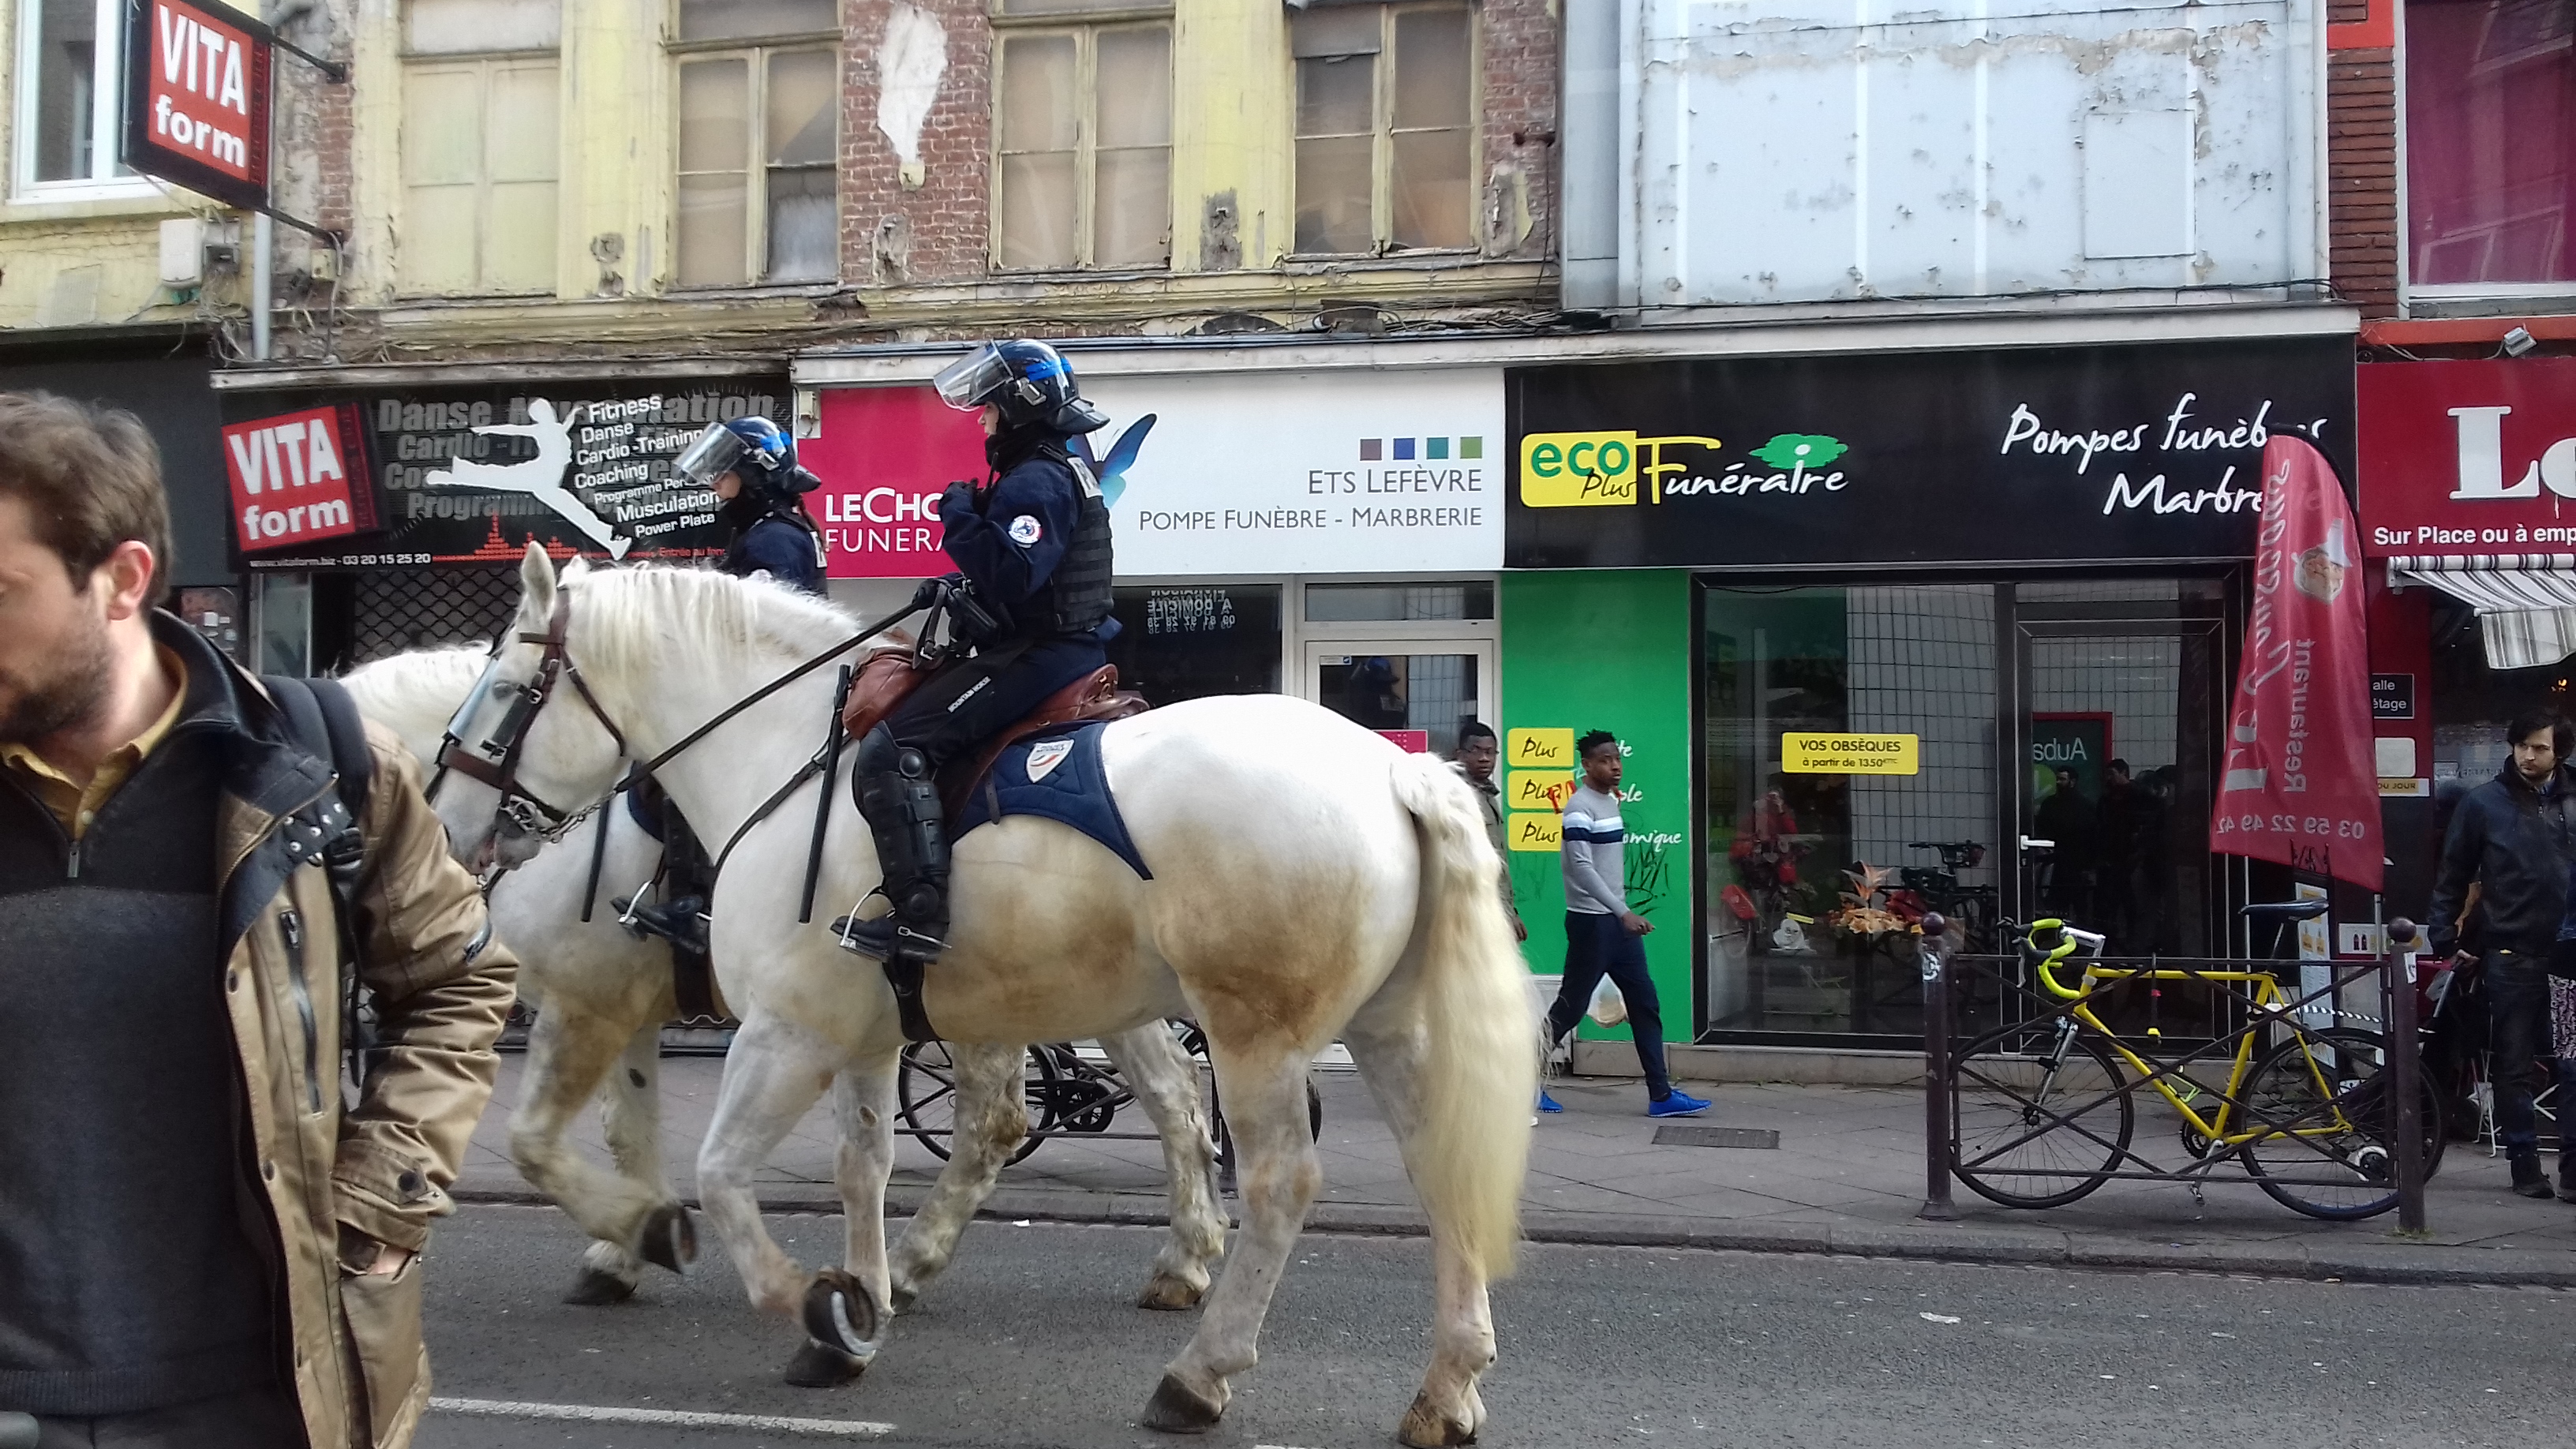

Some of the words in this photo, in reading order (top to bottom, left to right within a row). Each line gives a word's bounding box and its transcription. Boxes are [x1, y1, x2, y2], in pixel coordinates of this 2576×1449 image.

[159, 3, 246, 115] VITA
[155, 93, 245, 168] form
[379, 398, 492, 432] Danse
[588, 395, 661, 424] Fitness
[581, 421, 635, 444] Danse
[2001, 402, 2150, 474] Pompes
[229, 418, 343, 495] VITA
[576, 443, 631, 466] Cardio
[1530, 440, 1631, 477] eco
[575, 463, 649, 489] Coaching
[1309, 470, 1357, 494] ETS
[1368, 464, 1482, 493] LEFÈVRE
[1580, 471, 1637, 500] Plus
[1635, 435, 1849, 504] Funéraire
[593, 482, 662, 505] Programme
[243, 498, 350, 541] form
[616, 491, 720, 523] Musculation
[1140, 511, 1216, 531] POMPE
[1224, 505, 1327, 530] FUNÈBRE
[1352, 507, 1482, 527] MARBRERIE
[635, 521, 678, 538] Power
[680, 512, 715, 529] Plate
[2374, 526, 2412, 545] Sur
[2417, 526, 2476, 544] Place
[2481, 528, 2508, 543] ou
[2514, 522, 2528, 542] à
[342, 555, 358, 565] 03
[361, 555, 377, 564] 20
[380, 554, 395, 564] 15
[396, 554, 413, 564] 25
[414, 553, 431, 564] 20
[1521, 736, 1559, 758] Plus
[1799, 739, 1827, 751] VOS
[1830, 738, 1901, 752] OBSÈQUES
[1802, 757, 1810, 766] à
[1812, 757, 1840, 769] partir
[1842, 757, 1855, 767] de
[1522, 821, 1560, 843] Plus
